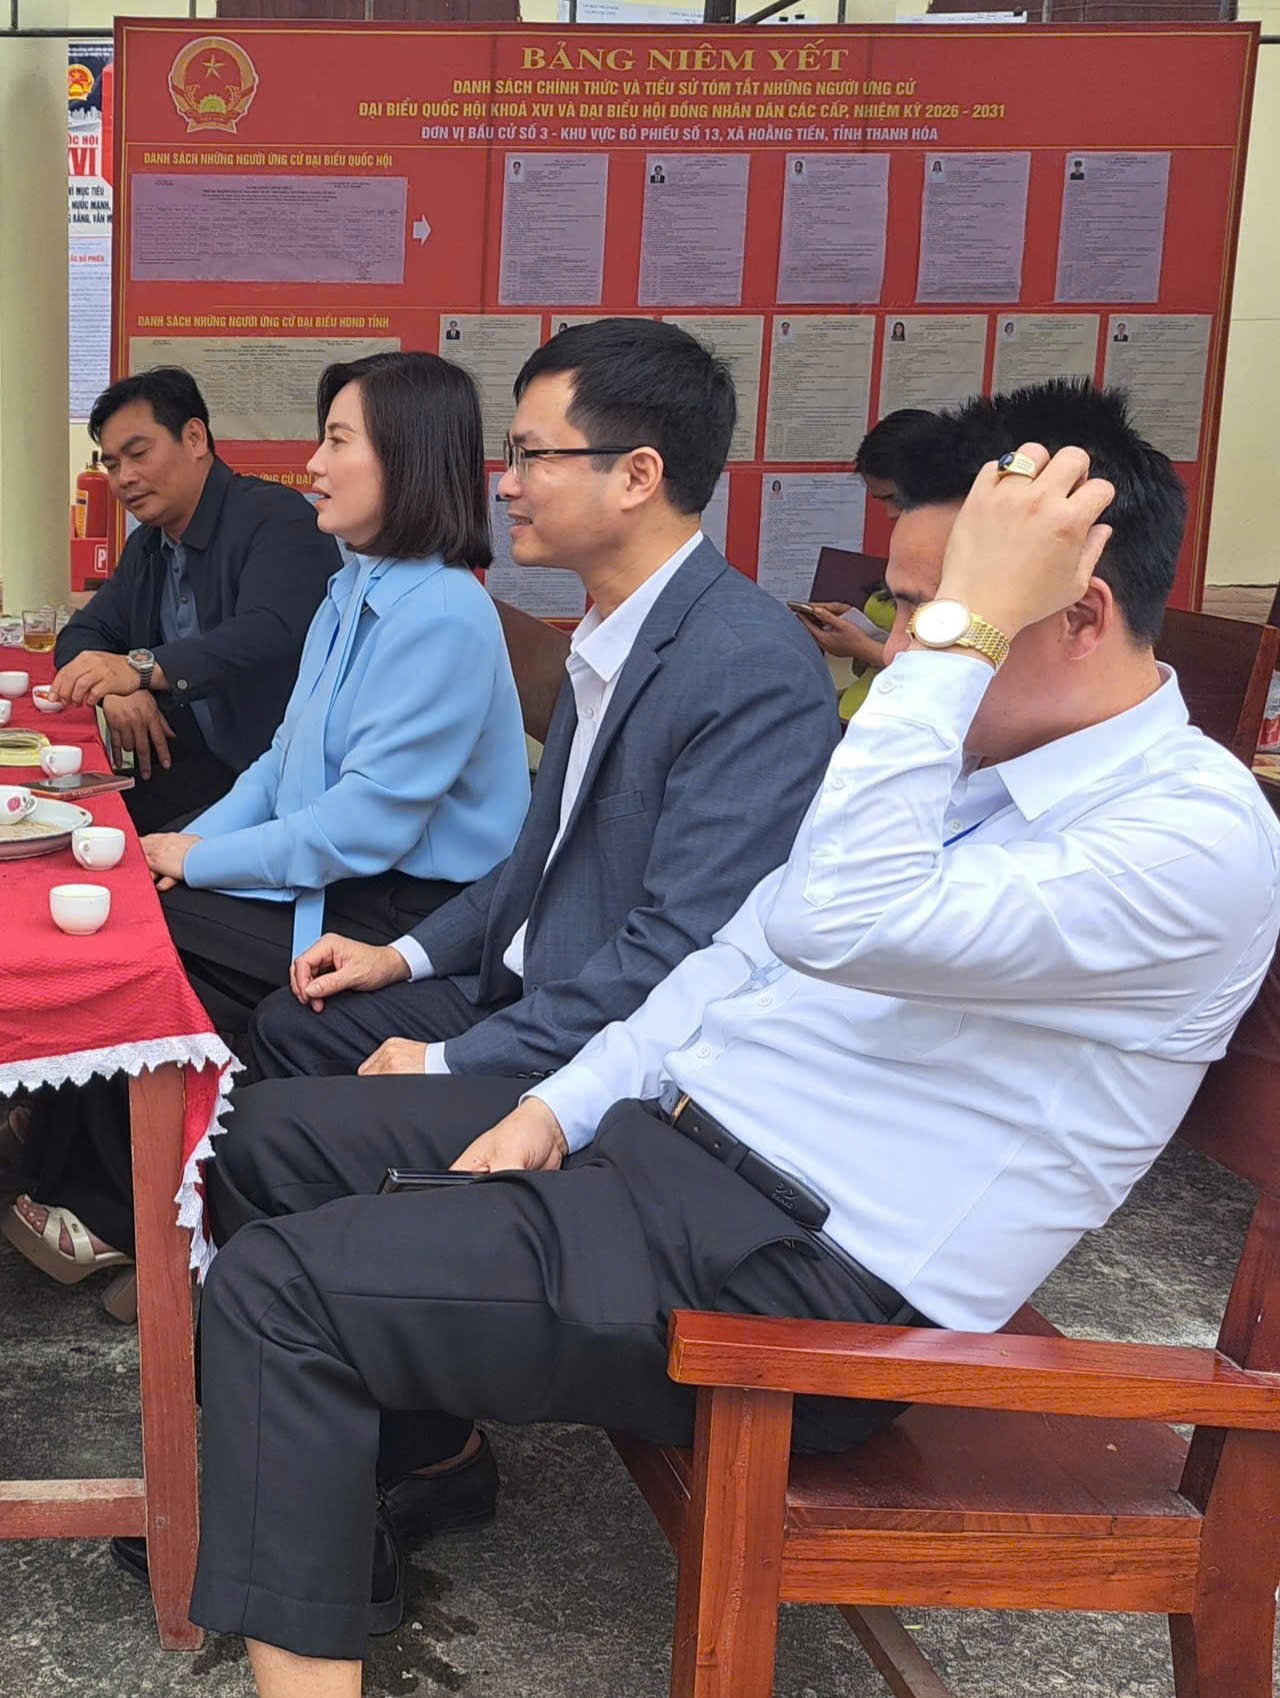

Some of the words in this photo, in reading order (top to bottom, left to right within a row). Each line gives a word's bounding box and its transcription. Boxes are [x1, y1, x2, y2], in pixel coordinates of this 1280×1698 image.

[521, 40, 636, 71] BẢNG
[648, 42, 756, 71] NIÊM
[770, 39, 849, 71] YẾT
[453, 80, 491, 94] DANH
[495, 78, 532, 94] SÁCH
[537, 78, 579, 94] CHÍNH
[583, 78, 618, 95] THỨC
[623, 78, 641, 95] VÀ
[645, 76, 674, 95] TIỂU
[678, 77, 699, 95] SỬ
[701, 78, 731, 95] TÓM
[736, 77, 760, 95] TẮT
[763, 78, 812, 95] NHỮNG
[816, 78, 858, 95] NGƯỜI
[863, 78, 892, 95] ỨNG
[896, 77, 917, 95] CỬ
[359, 103, 383, 119] ĐẠI
[386, 98, 418, 116] BIỂU
[422, 98, 459, 117] QUỐC
[463, 102, 486, 119] HỘI
[490, 102, 528, 117] KHOÁ
[531, 103, 554, 117] XVI
[558, 101, 576, 117] VÀ
[579, 103, 603, 120] ĐẠI
[607, 99, 638, 118] BIỂU
[643, 102, 666, 120] HỘI
[671, 101, 708, 118] ĐỒNG
[712, 102, 751, 118] NHÂN
[756, 102, 784, 118] DÂN
[788, 102, 816, 118] CÁC
[820, 100, 849, 119] CẤP,
[854, 102, 899, 120] NHIỆM
[903, 101, 922, 118] KỲ
[925, 104, 959, 118] 2026
[972, 104, 1005, 118] 2031
[82, 134, 98, 146] HỘI
[421, 125, 449, 139] ĐƠN
[452, 127, 464, 142] VỊ
[468, 123, 494, 139] BẦU
[498, 122, 516, 139] CỬ
[519, 122, 537, 139] SỐ
[540, 127, 548, 139] 3
[560, 127, 587, 140] KHU
[590, 126, 616, 142] VỰC
[620, 123, 637, 140] BỎ
[640, 124, 678, 141] PHIẾU
[682, 124, 701, 141] SỐ
[704, 127, 723, 141] 13,
[727, 125, 744, 141] XÃ
[748, 124, 793, 141] HOẰNG
[796, 124, 828, 142] TIẾN,
[832, 124, 862, 141] TỈNH
[866, 127, 908, 141] THANH
[911, 125, 939, 141] HÓA
[68, 147, 97, 177] VI
[144, 152, 170, 164] DANH
[173, 151, 198, 165] SÁCH
[200, 151, 234, 165] NHỮNG
[236, 151, 265, 165] NGƯỜI
[268, 152, 288, 165] ỨNG
[290, 151, 304, 166] CỬ
[305, 153, 321, 168] ĐẠI
[324, 150, 345, 166] BIỂU
[348, 151, 374, 166] QUỐC
[376, 153, 392, 168] HỘI
[76, 186, 90, 198] MỤC
[138, 315, 164, 327] DANH
[166, 314, 191, 327] SÁCH
[193, 314, 226, 327] NHỮNG
[228, 314, 258, 328] NGƯỜI
[261, 314, 280, 328] ỨNG
[282, 313, 296, 328] CỬ
[297, 316, 313, 329] ĐẠI
[315, 312, 337, 328] BIỂU
[281, 470, 295, 485] CỬ
